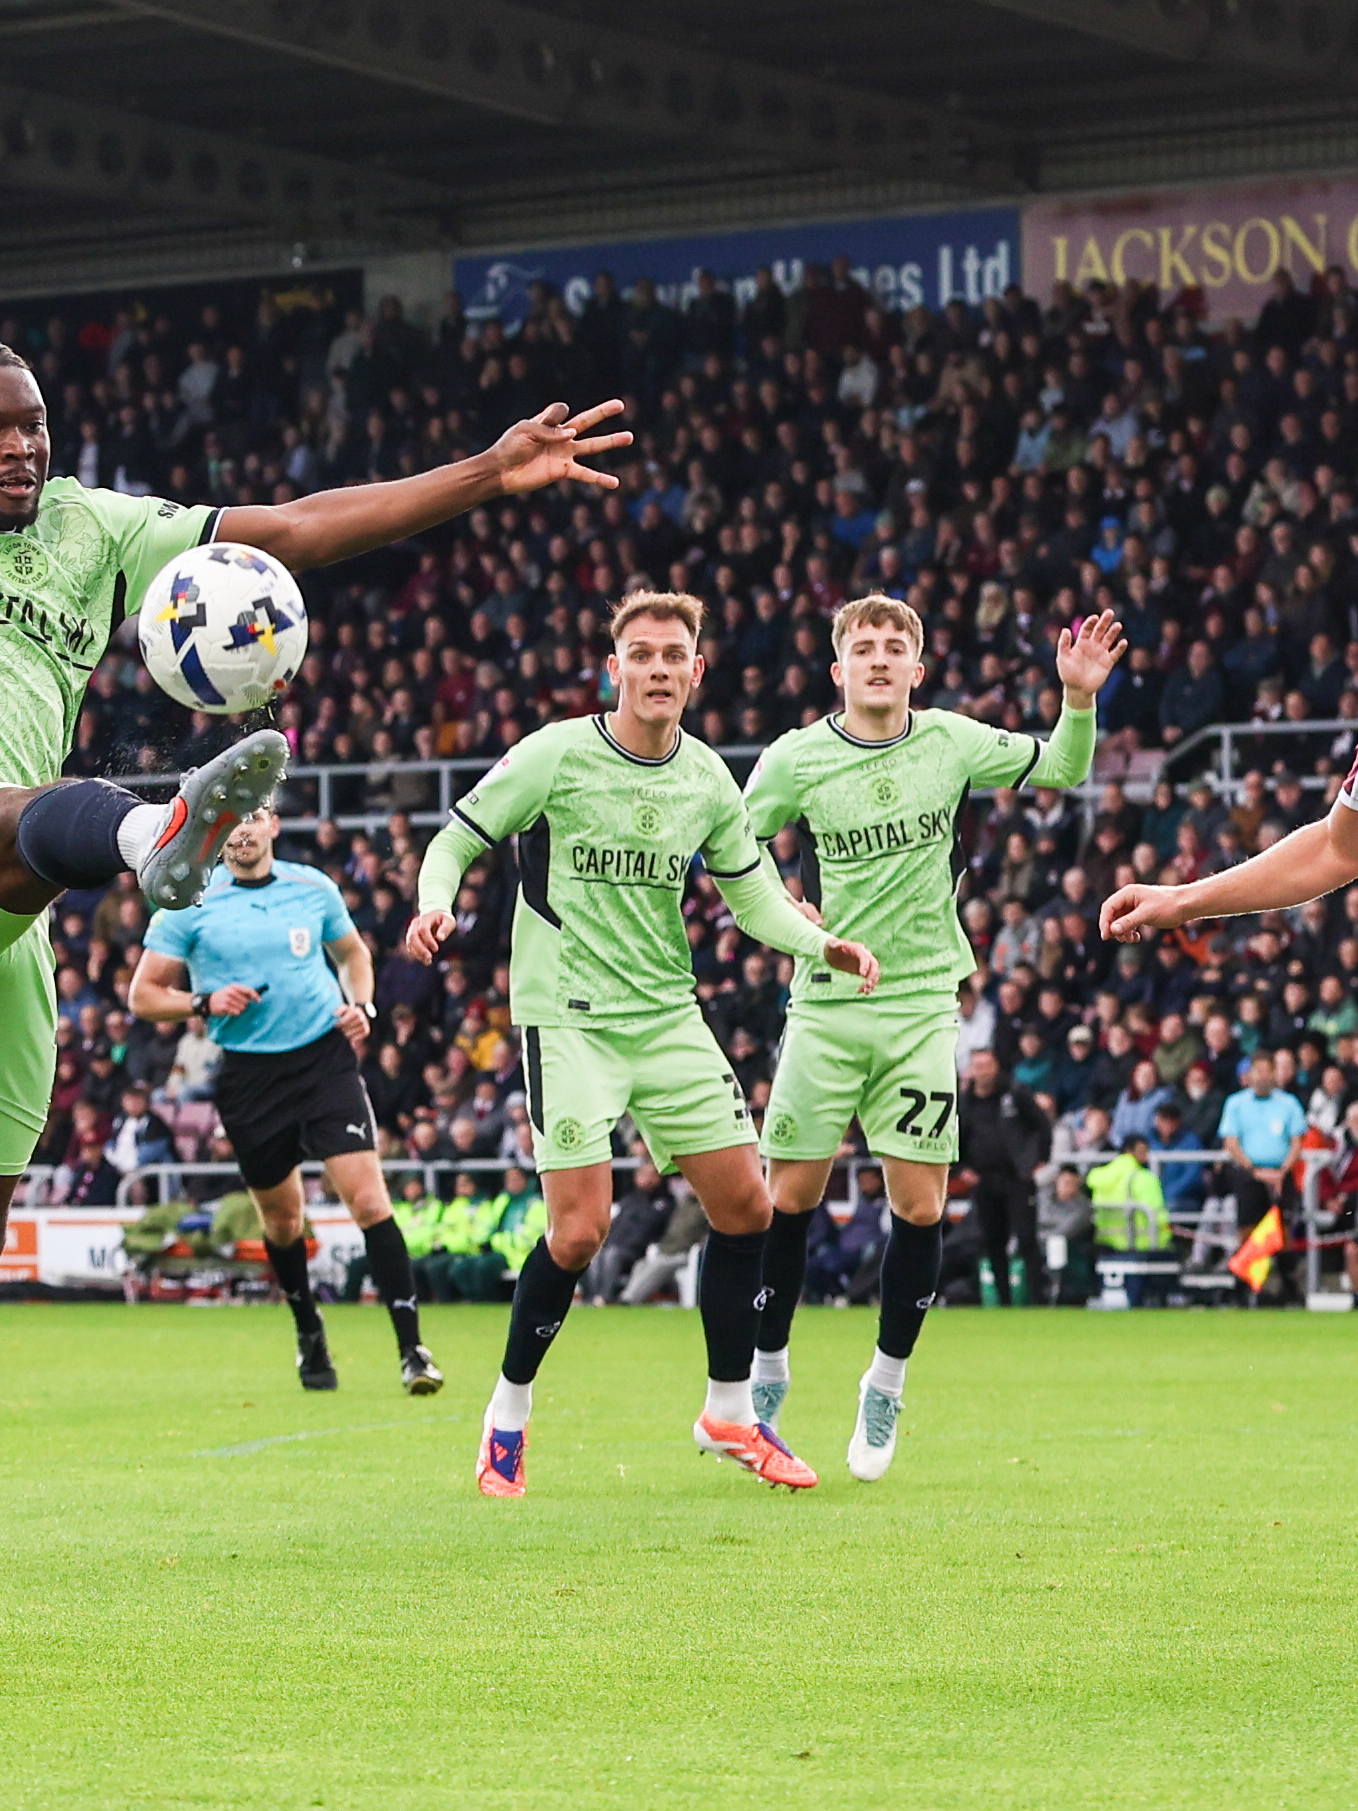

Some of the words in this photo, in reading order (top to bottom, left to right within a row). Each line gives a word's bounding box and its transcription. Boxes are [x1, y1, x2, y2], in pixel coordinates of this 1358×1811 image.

[938, 240, 1009, 308] Ltd
[1051, 212, 1328, 292] JACKSON
[822, 818, 914, 858] CAPITAL
[917, 805, 952, 839] SKY
[572, 845, 659, 880] CAPITAL
[896, 1087, 955, 1138] 27
